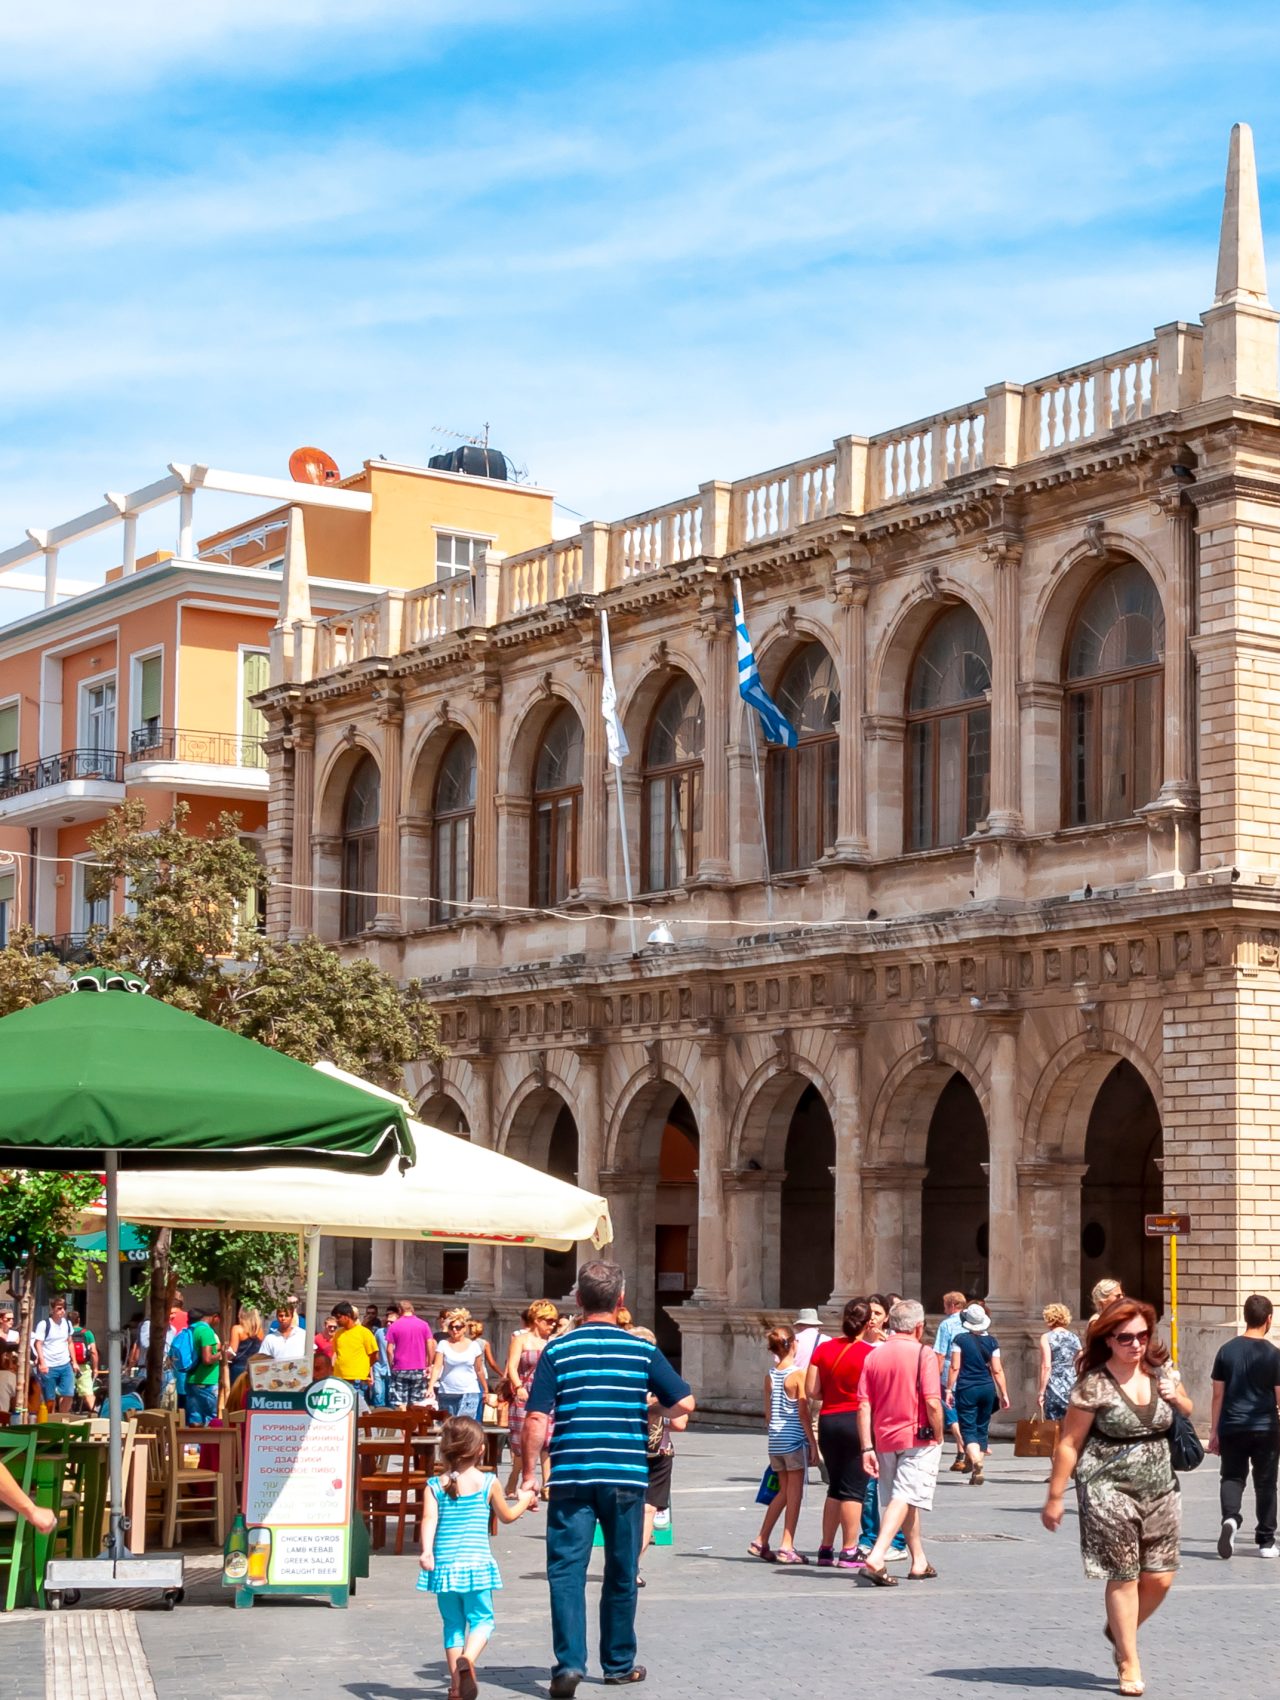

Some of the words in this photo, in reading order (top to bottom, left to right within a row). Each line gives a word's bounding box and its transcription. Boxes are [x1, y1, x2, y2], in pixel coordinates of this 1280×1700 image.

[251, 1396, 293, 1409] Menu
[262, 1423, 306, 1431] КУРИНЫЙ
[254, 1434, 283, 1442] ГИРОС
[285, 1434, 297, 1442] ИЗ
[299, 1434, 345, 1442] СВИНИНЫ
[257, 1444, 309, 1452] ГРЕЧЕСКИЙ
[311, 1444, 340, 1452] САЛАТ
[259, 1466, 309, 1474] БОЧКОВОЕ
[311, 1466, 336, 1474] ПИВО
